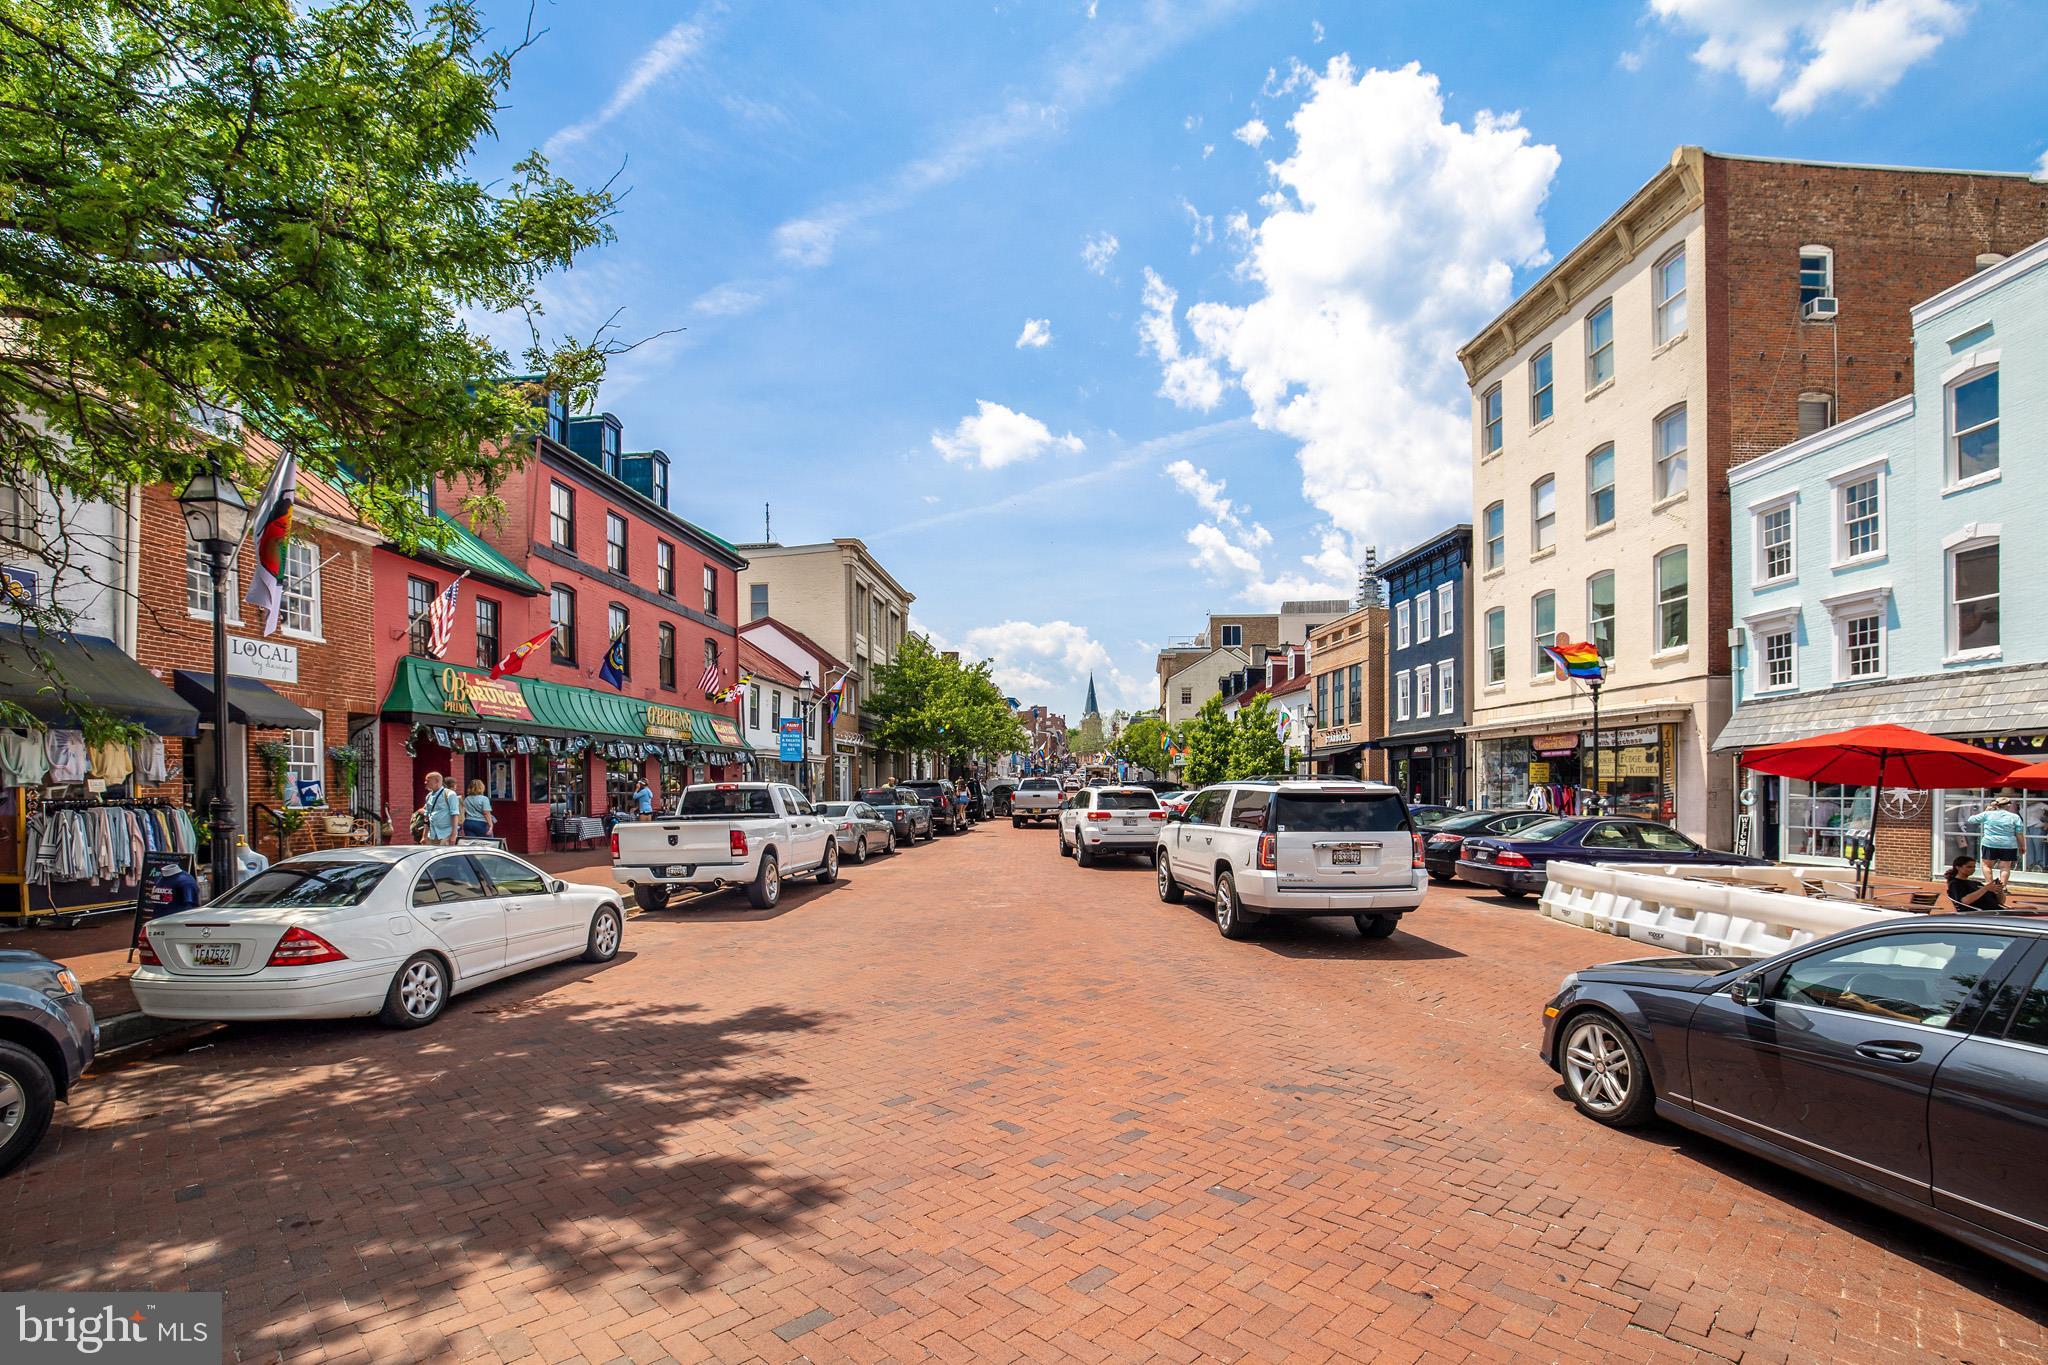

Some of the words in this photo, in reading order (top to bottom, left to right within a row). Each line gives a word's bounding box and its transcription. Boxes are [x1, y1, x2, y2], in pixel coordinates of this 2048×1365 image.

[232, 639, 293, 663] LOCAL
[466, 684, 528, 708] BRUNCH
[444, 700, 470, 715] PRIME
[1325, 732, 1351, 743] STARBUCKS
[1174, 754, 1181, 764] P
[1620, 753, 1641, 764] FUDGE
[1629, 764, 1658, 774] KITCHEN
